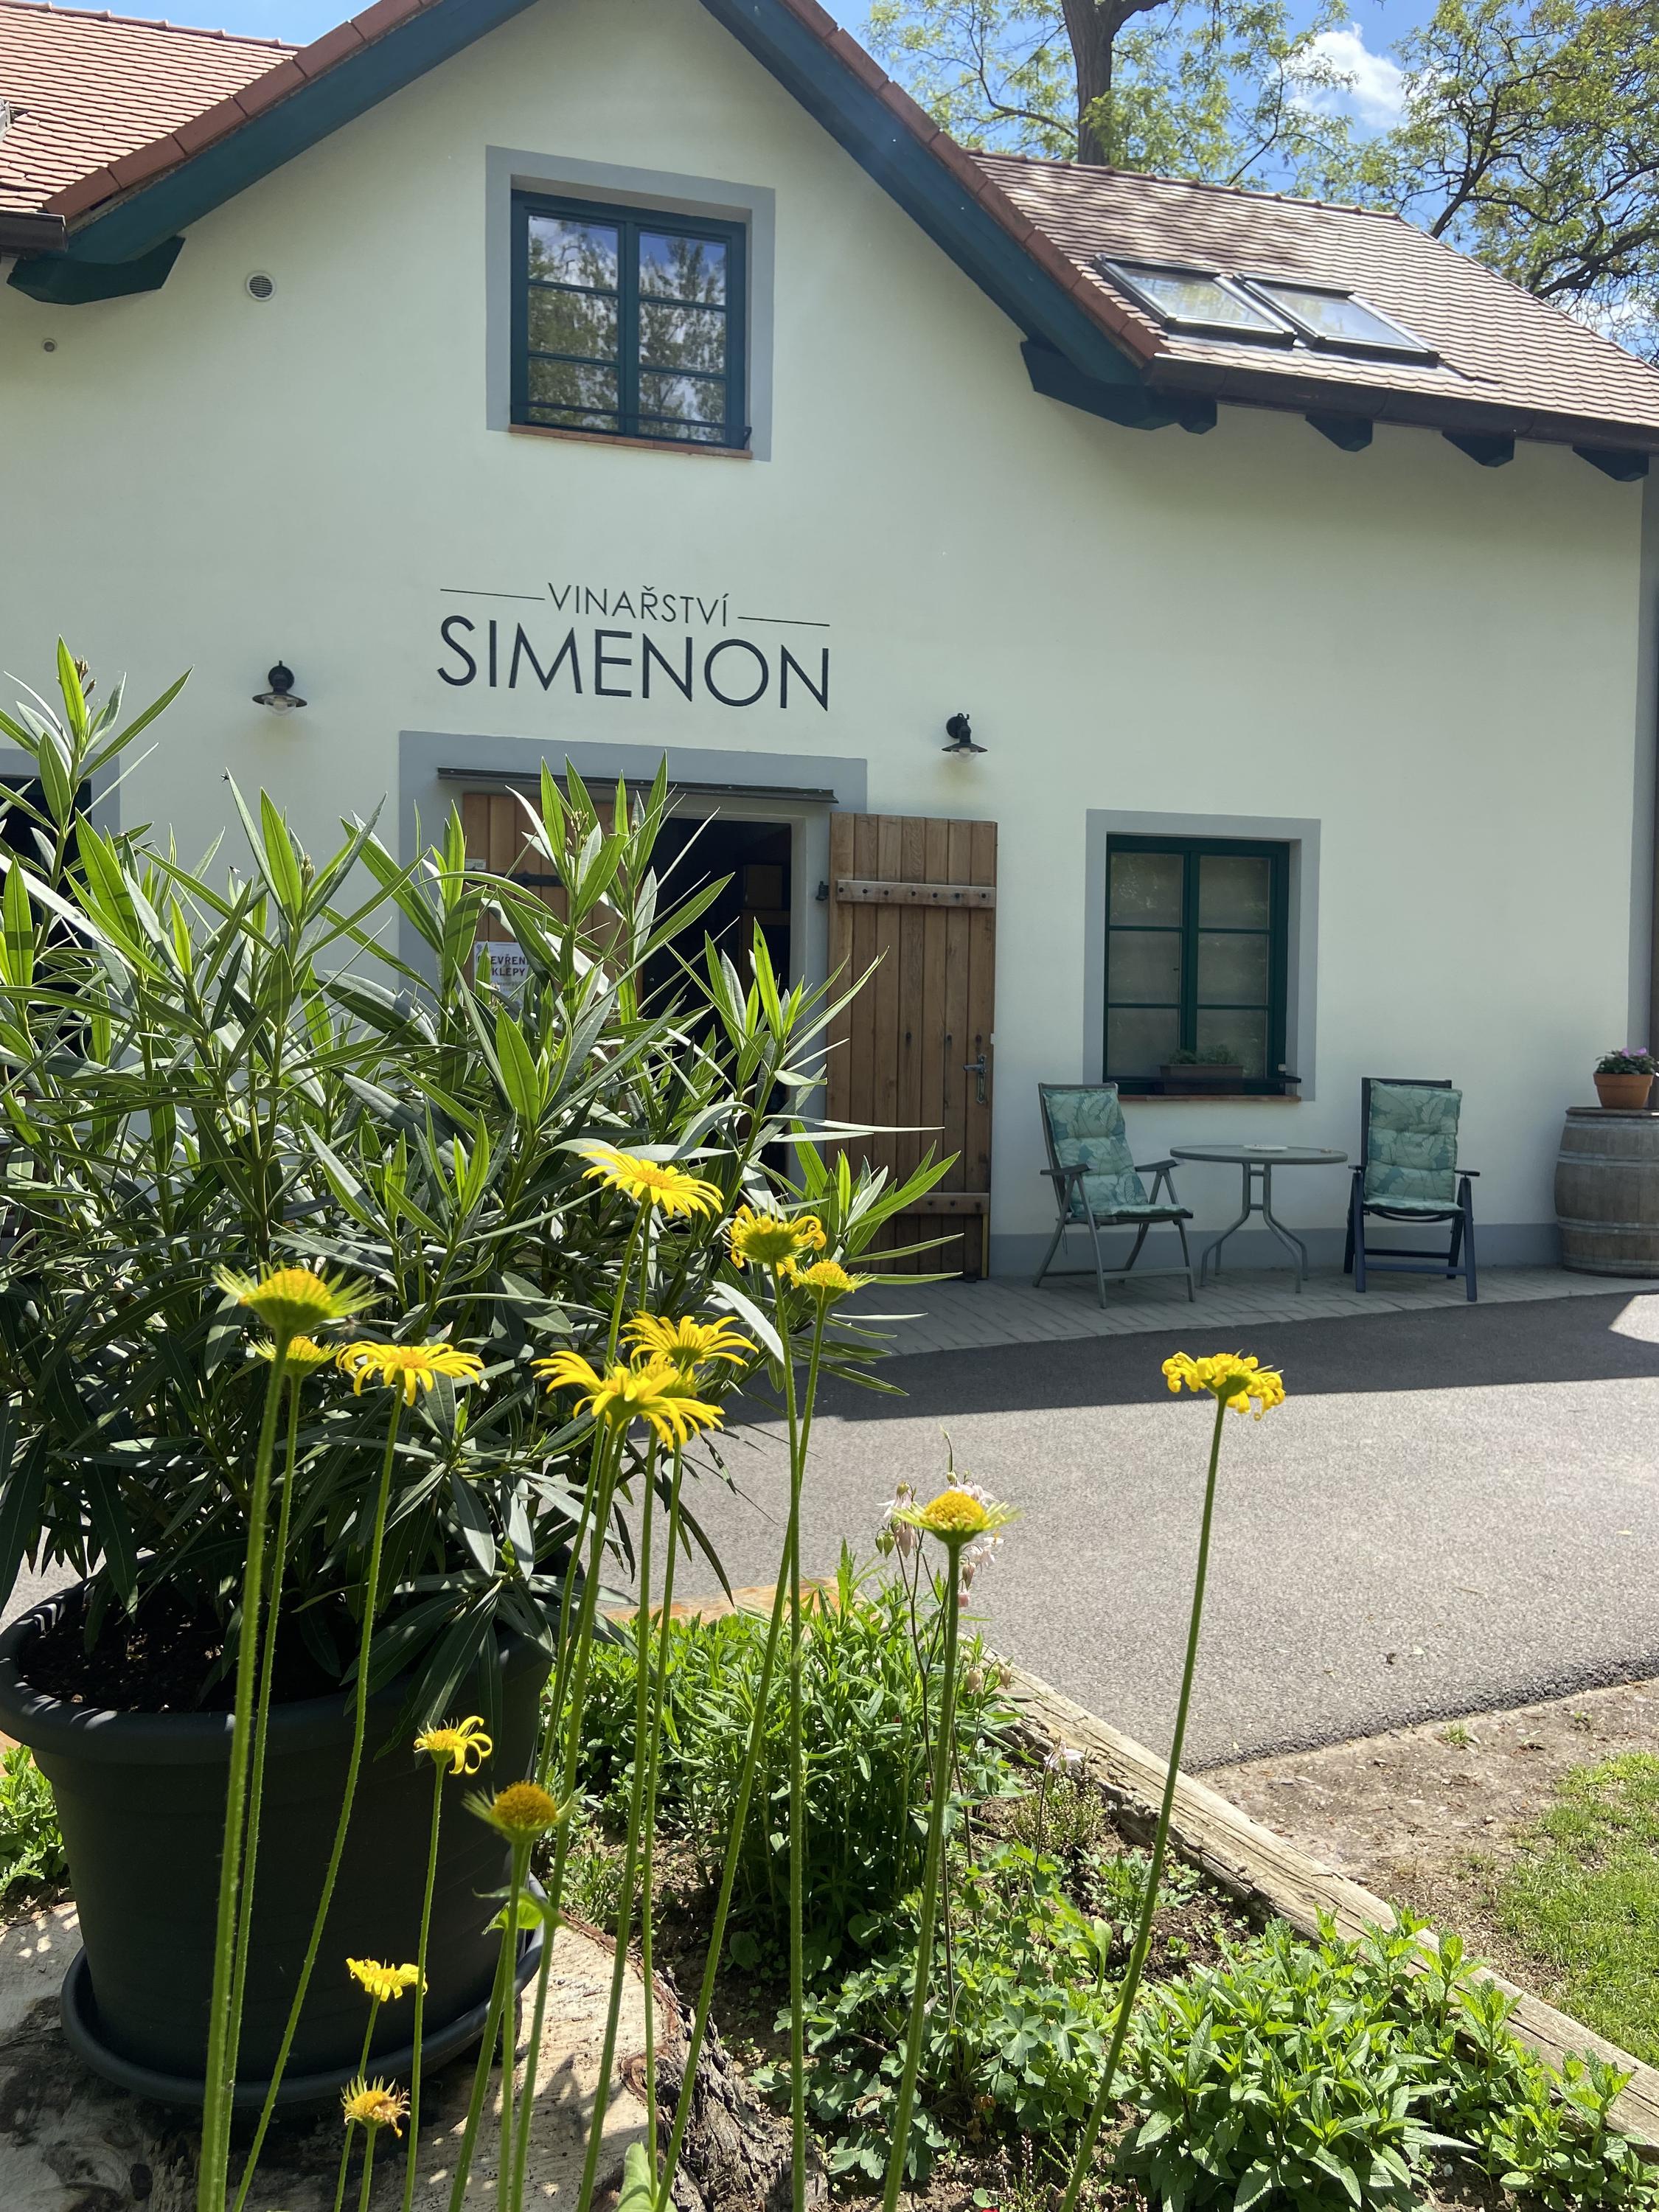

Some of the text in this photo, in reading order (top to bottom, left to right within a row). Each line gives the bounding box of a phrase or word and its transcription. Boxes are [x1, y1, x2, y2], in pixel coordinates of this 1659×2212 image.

[548, 582, 729, 627] VINAŘSTVÍ
[437, 615, 830, 712] SIMENON
[478, 953, 529, 965] EVŘEN
[492, 967, 526, 976] KLEPY
